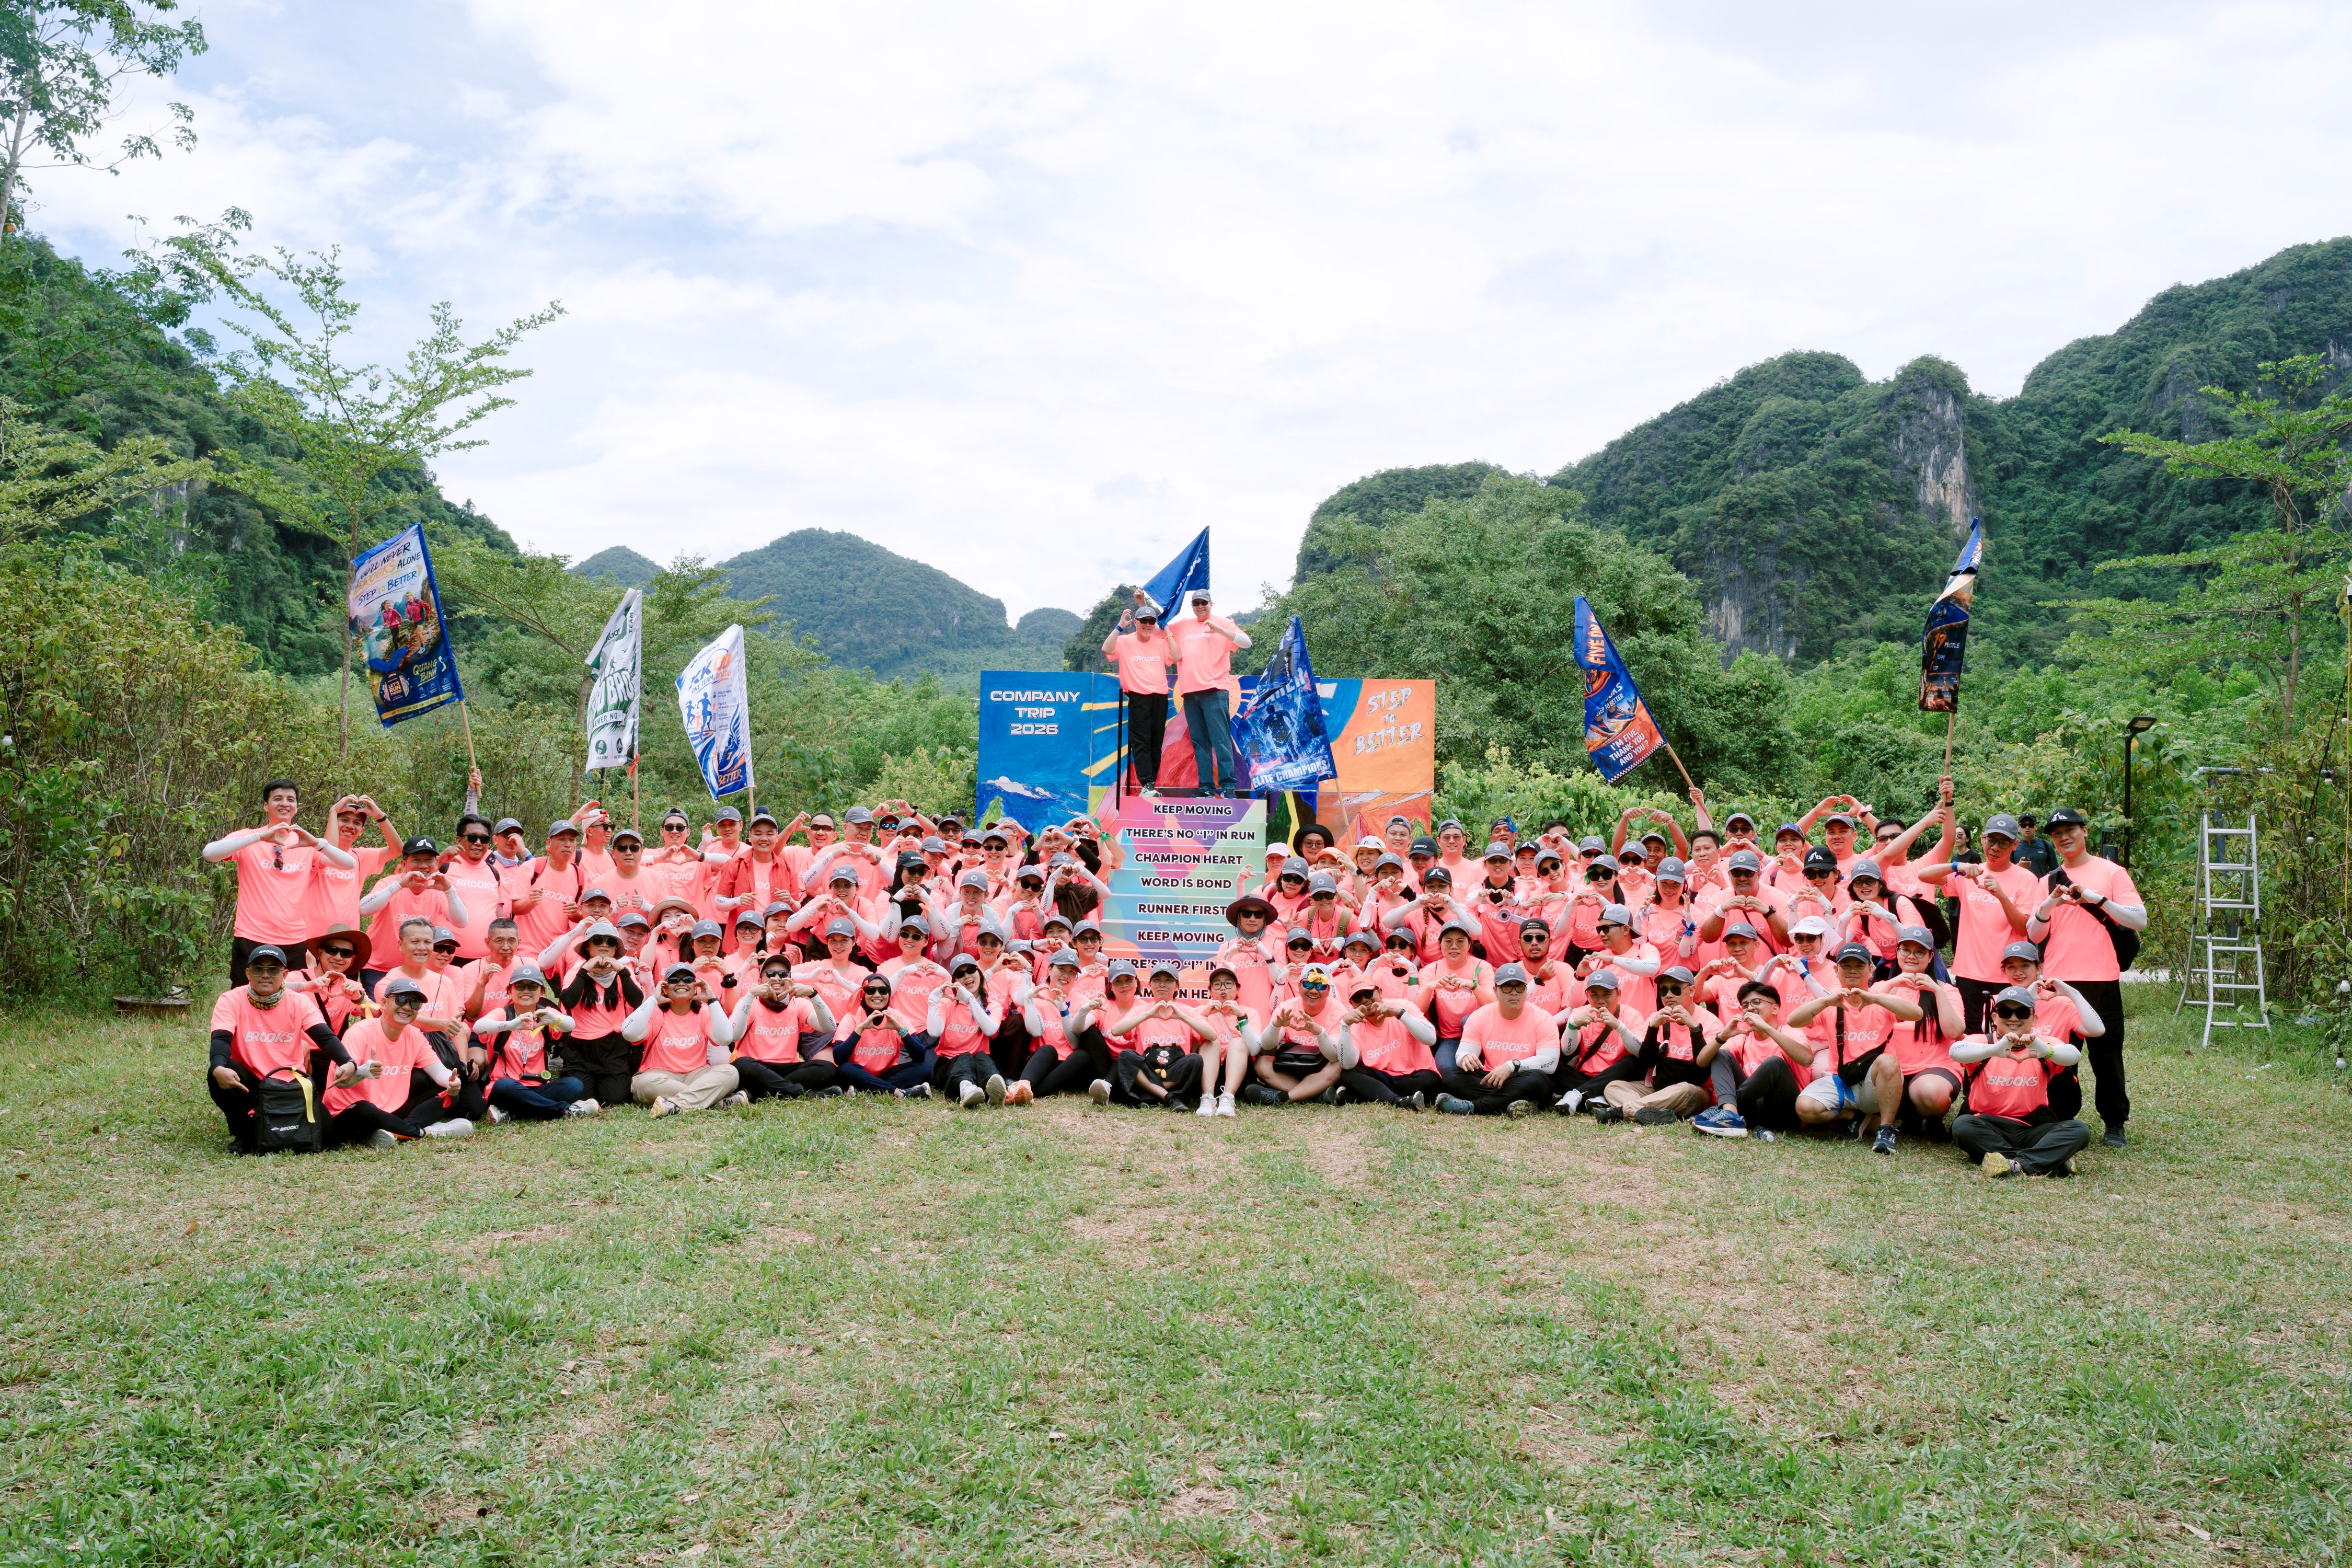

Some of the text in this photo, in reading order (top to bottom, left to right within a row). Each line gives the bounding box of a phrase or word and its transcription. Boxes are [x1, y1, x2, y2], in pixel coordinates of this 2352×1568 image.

[381, 542, 411, 566] NEVER
[397, 551, 421, 569] ALONE
[358, 570, 417, 606] STEP TO BETTER
[699, 643, 720, 660] BROOKS
[1585, 639, 1606, 665] FIVE
[413, 659, 437, 675] QUANG
[389, 684, 401, 693] RUN
[691, 684, 701, 694] ONE
[990, 690, 1080, 702] COMPANY
[1367, 687, 1413, 714] STEP
[1609, 693, 1624, 706] BETTER
[1014, 707, 1055, 718] TRIP
[1382, 713, 1396, 724] TO
[1010, 723, 1058, 735] 2026
[1355, 722, 1424, 756] BETTER
[1610, 728, 1639, 752] I'M FIVE,
[1609, 733, 1645, 761] THANK YOU
[1619, 752, 1633, 766] AND
[1632, 743, 1645, 756] YOU
[719, 768, 743, 786] BETTER
[1252, 760, 1327, 788] ELITE CHAMPIONS
[1154, 805, 1231, 815] KEEP MOVING
[1126, 828, 1173, 838] THERE'S
[1177, 830, 1194, 838] NO
[1216, 831, 1227, 839] IN
[1231, 831, 1254, 840] RUN
[1135, 853, 1243, 864] CHAMPION HEART
[456, 878, 495, 890] BROOKS
[803, 872, 816, 886] BROOKS
[1141, 878, 1231, 889] WORD IS BOND
[541, 890, 572, 903] ROOKS
[1139, 904, 1227, 915] RUNNER FIRST
[1138, 931, 1224, 942] KEEP MOVING
[897, 984, 930, 996] ROOKS
[754, 1025, 798, 1036] BROOKS
[244, 1032, 294, 1043] BROOKS
[1143, 1035, 1186, 1046] BROOKS
[855, 1046, 894, 1056] BROOKS
[1367, 1039, 1401, 1059] BROOKS
[1485, 1040, 1531, 1053] BROOKS
[1541, 1056, 1556, 1069] BROOKS
[1986, 1075, 2038, 1088] BROOKS
